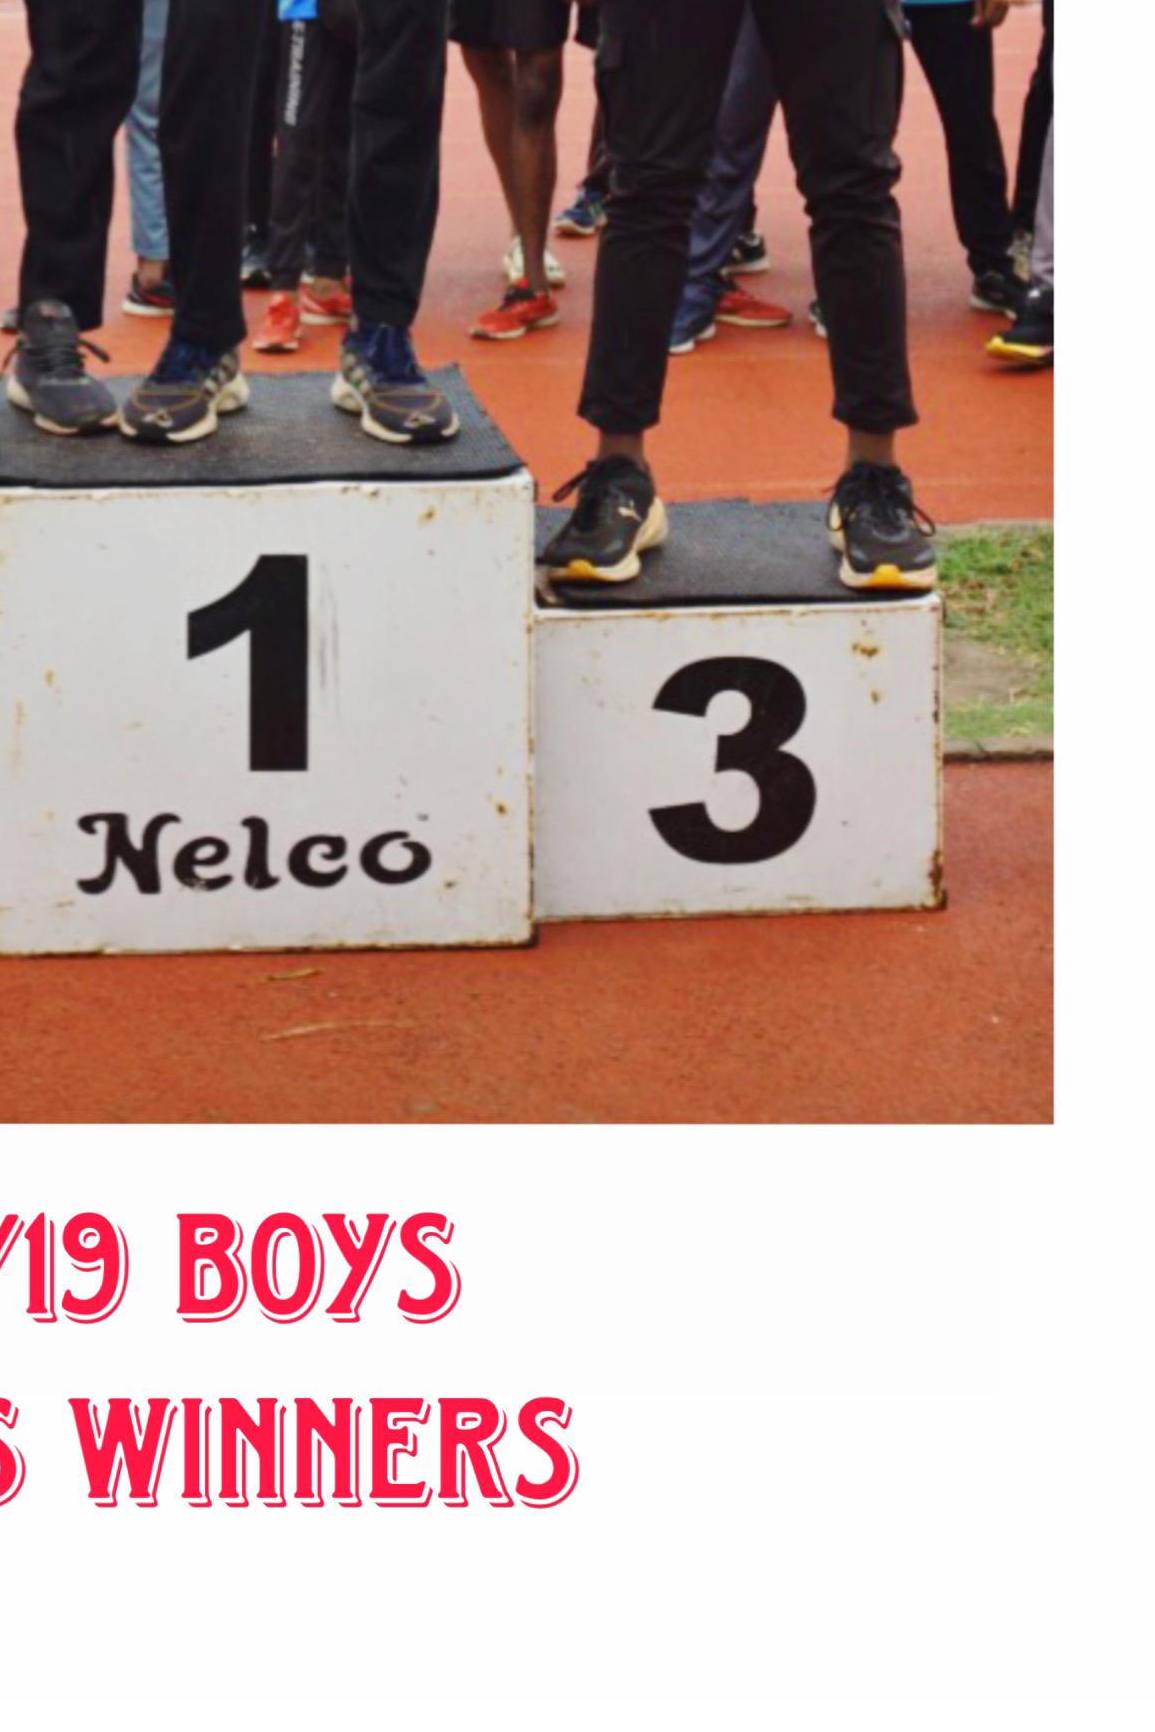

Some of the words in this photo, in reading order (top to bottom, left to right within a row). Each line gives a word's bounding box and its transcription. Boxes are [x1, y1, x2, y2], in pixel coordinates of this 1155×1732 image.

[187, 554, 308, 772] 1
[649, 656, 817, 864] 3
[77, 812, 432, 896] Nelco
